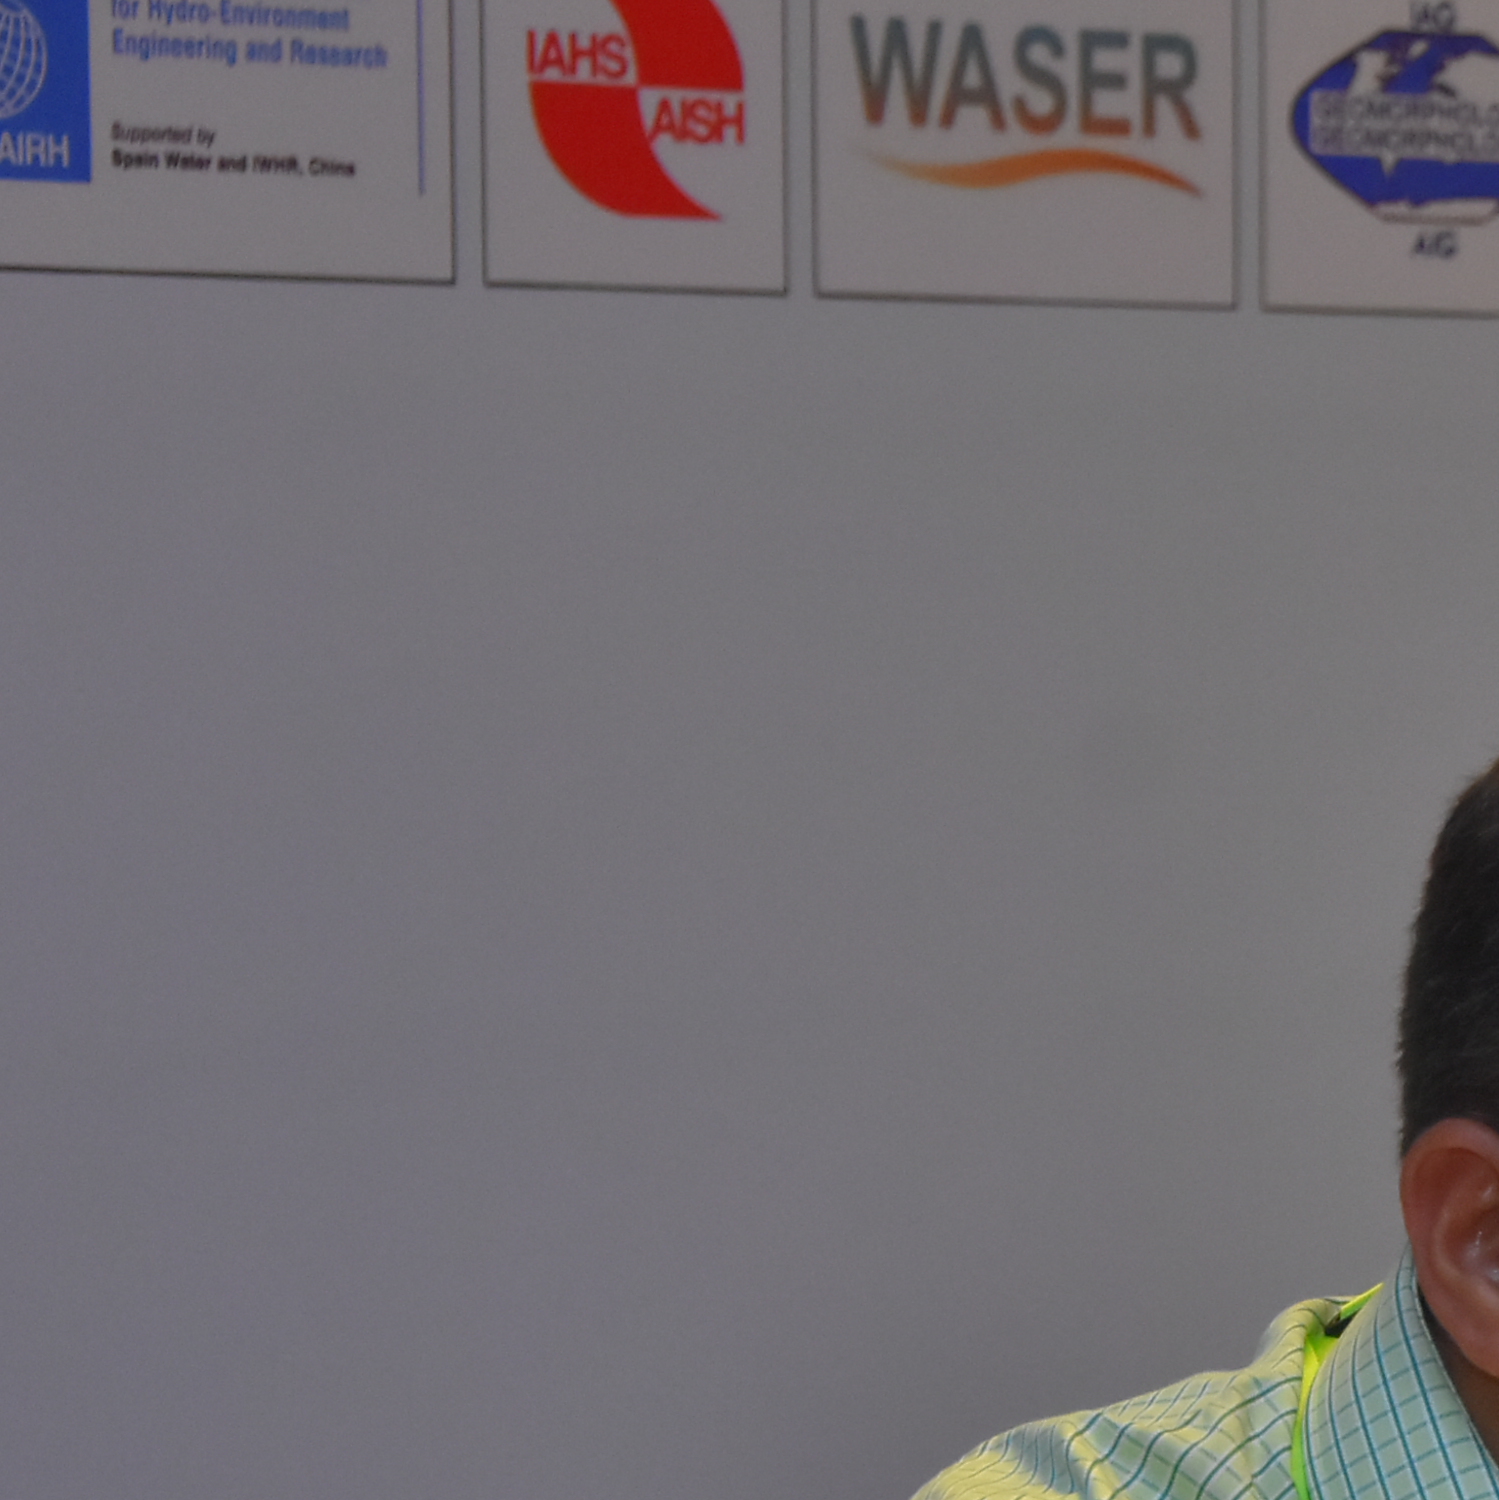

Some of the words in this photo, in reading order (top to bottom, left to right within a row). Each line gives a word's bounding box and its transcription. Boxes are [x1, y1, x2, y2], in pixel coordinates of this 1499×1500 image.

[112, 0, 138, 19] for
[148, 0, 350, 31] Hydro-Environment
[112, 28, 238, 67] Engineering
[245, 37, 283, 64] and
[290, 38, 389, 69] Research
[527, 29, 630, 80] IAHS
[850, 14, 1202, 141] WASER
[111, 121, 193, 145] Supported
[196, 125, 215, 148] by
[647, 97, 745, 145] AISH
[111, 149, 159, 171] Spain
[217, 155, 248, 173] and
